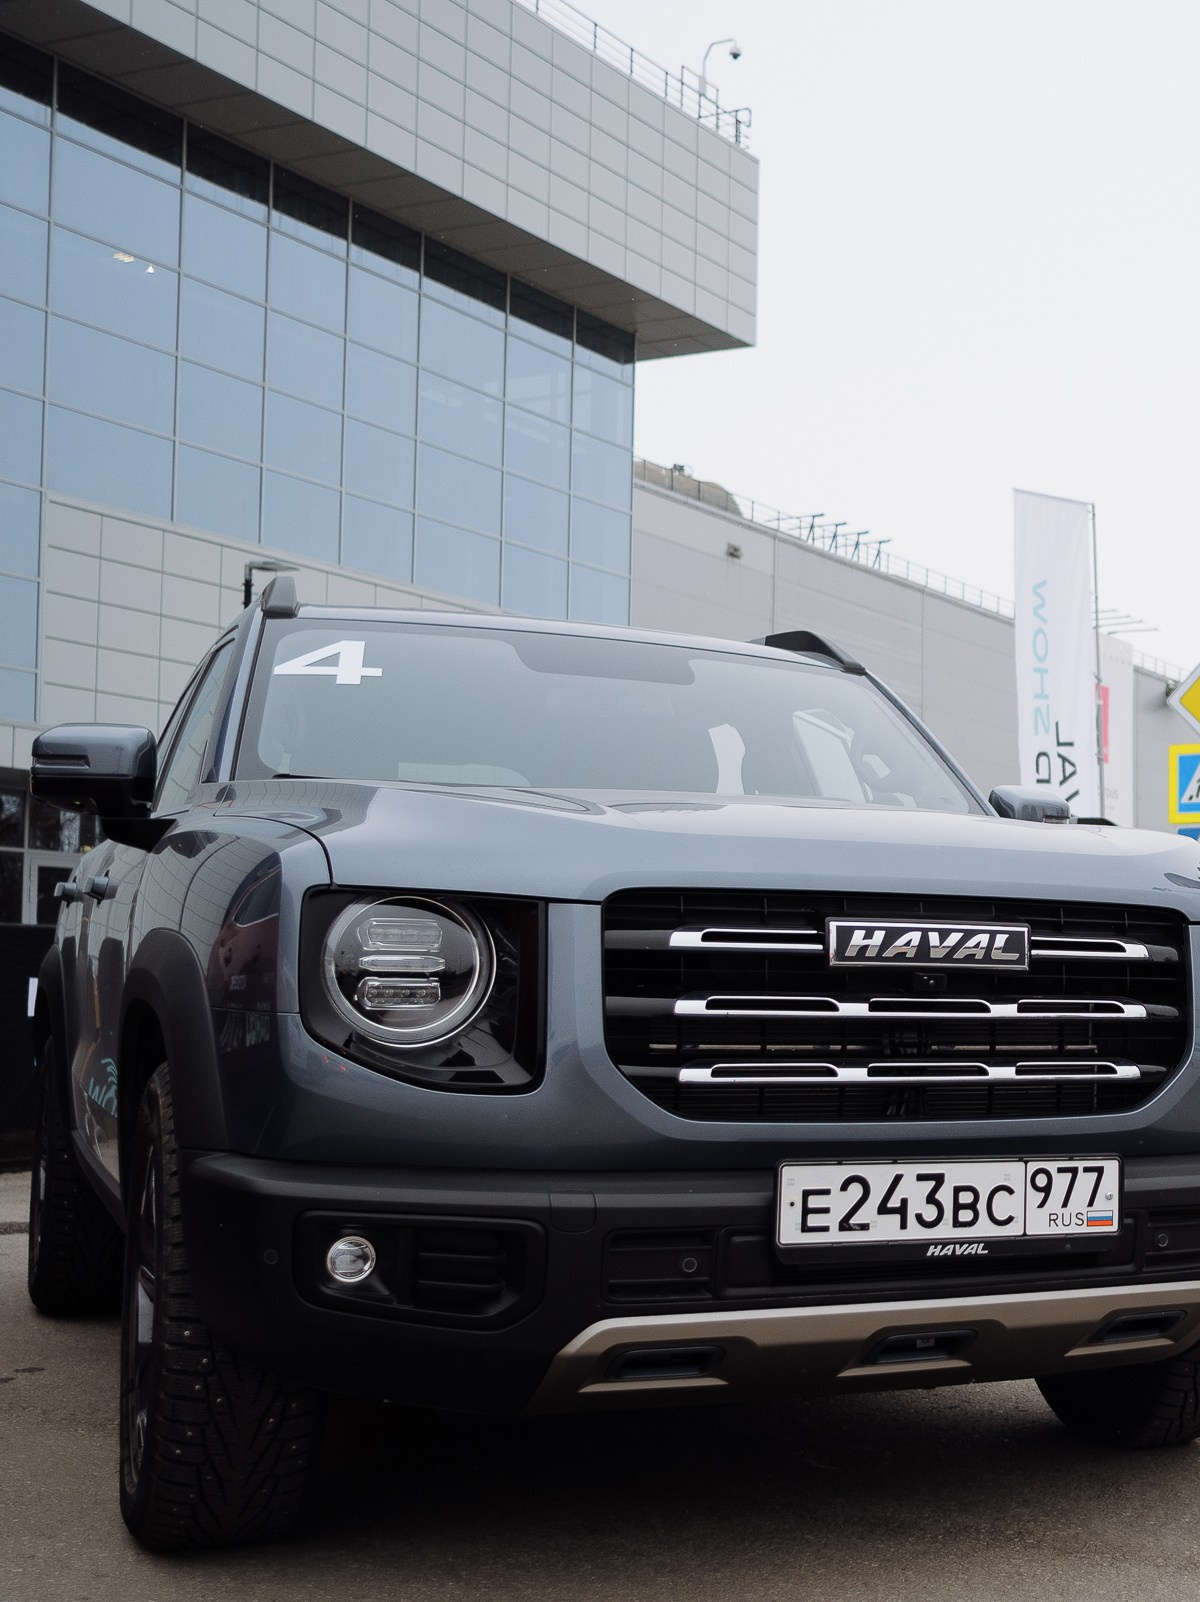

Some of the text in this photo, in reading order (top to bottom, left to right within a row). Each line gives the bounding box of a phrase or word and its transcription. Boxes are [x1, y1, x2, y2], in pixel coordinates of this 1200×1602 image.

[273, 640, 382, 685] 4
[843, 929, 1021, 961] HAVAL
[1029, 1165, 1105, 1209] 977
[1048, 1211, 1084, 1227] RUS
[926, 1242, 989, 1257] HAVAL
